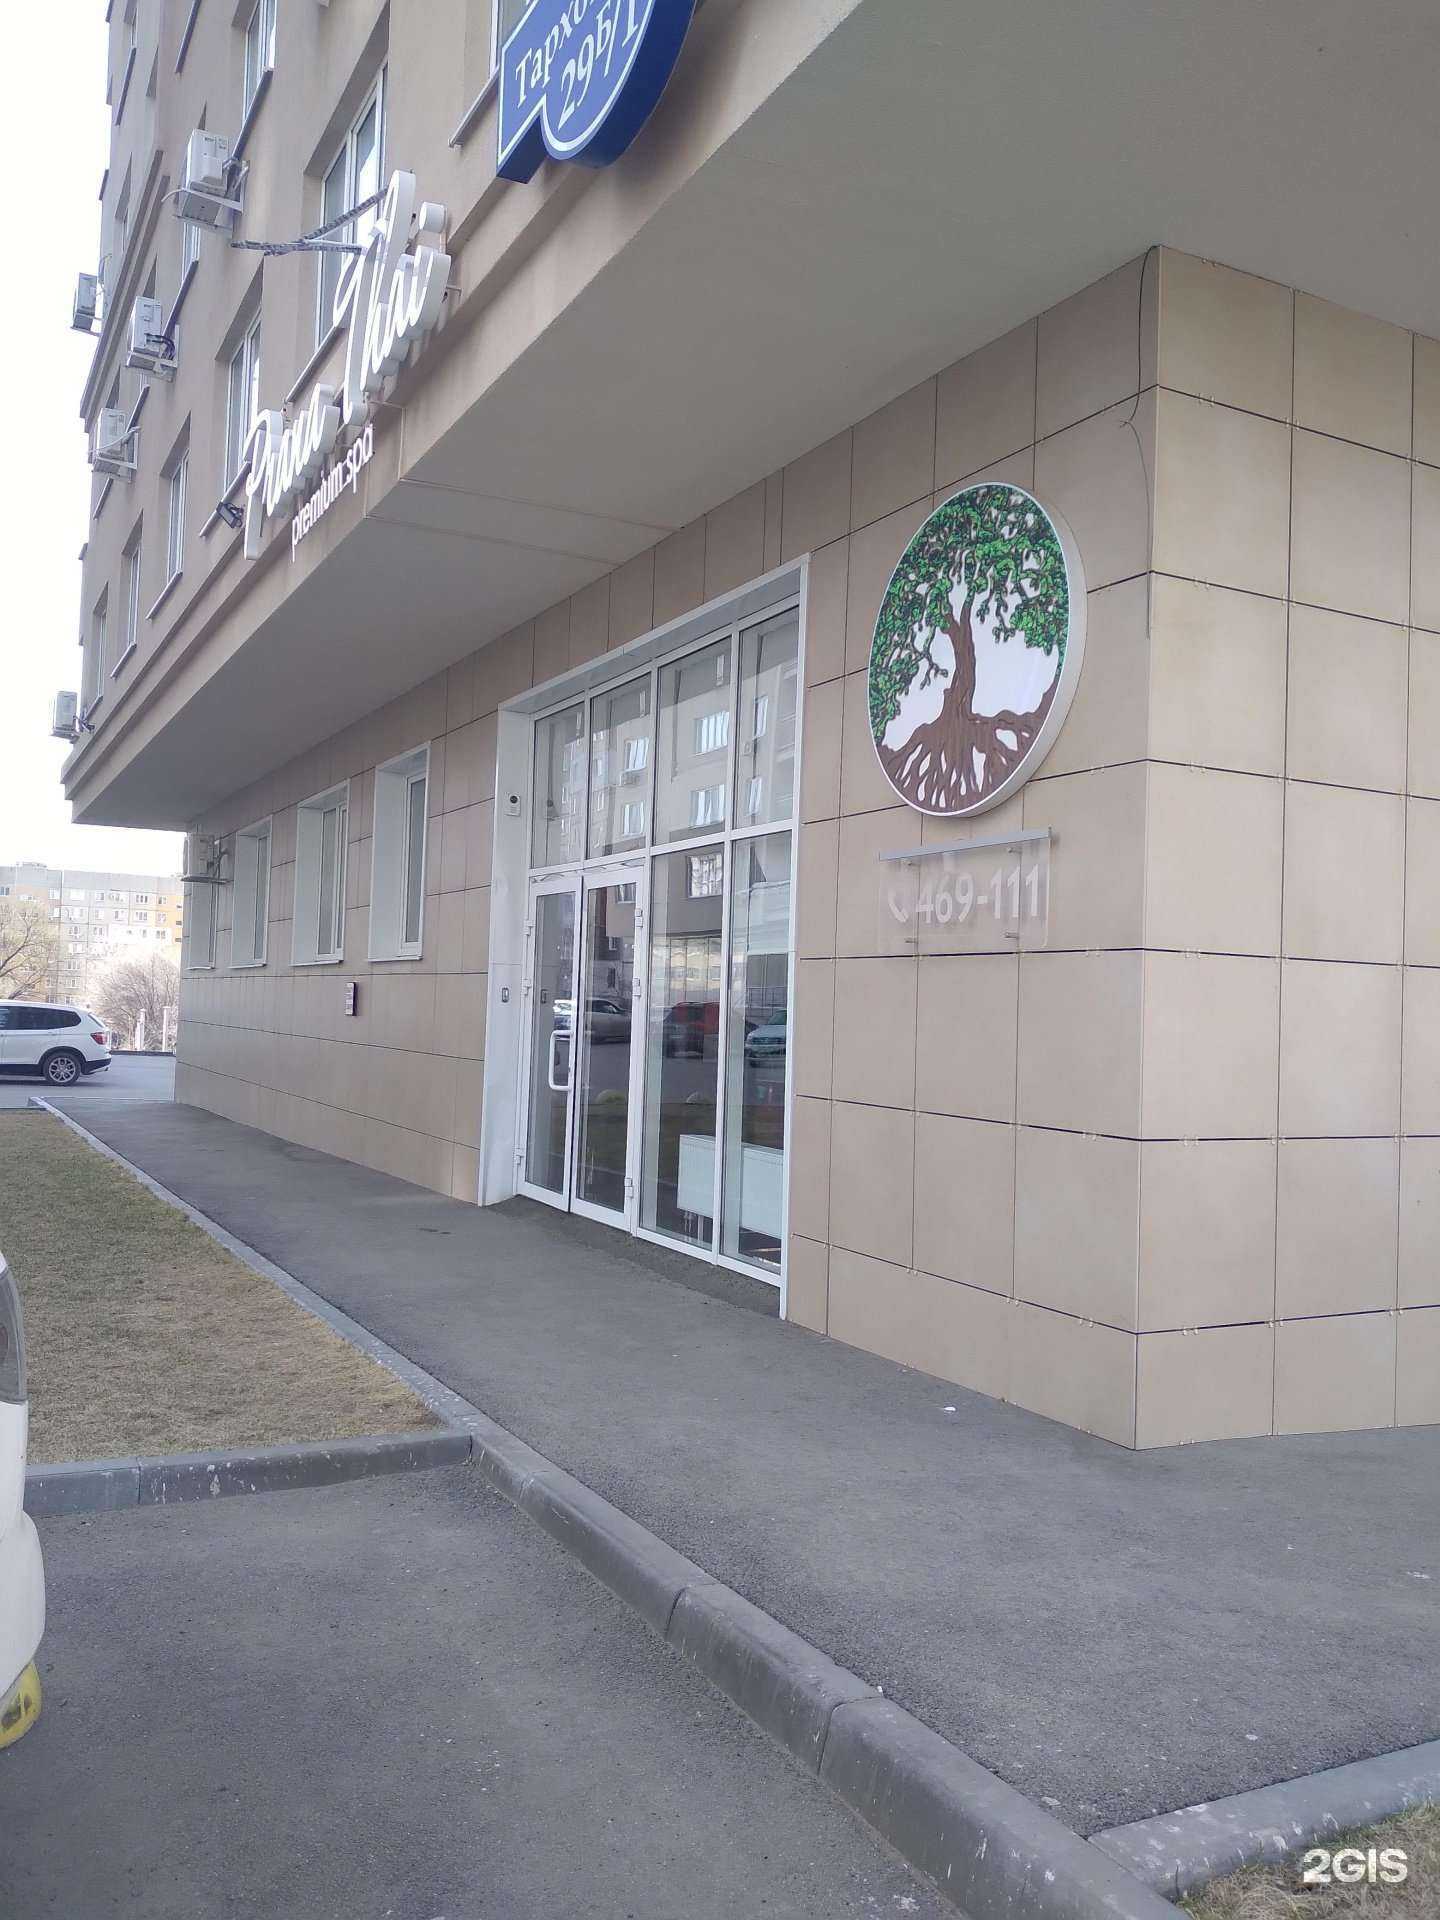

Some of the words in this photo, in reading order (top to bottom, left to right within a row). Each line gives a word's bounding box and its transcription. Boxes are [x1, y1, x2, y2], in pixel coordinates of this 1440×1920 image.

[515, 0, 595, 109] Тархо
[333, 170, 443, 424] Thai
[291, 460, 344, 563] premium
[345, 423, 374, 494] spa
[915, 863, 1039, 924] 469-111
